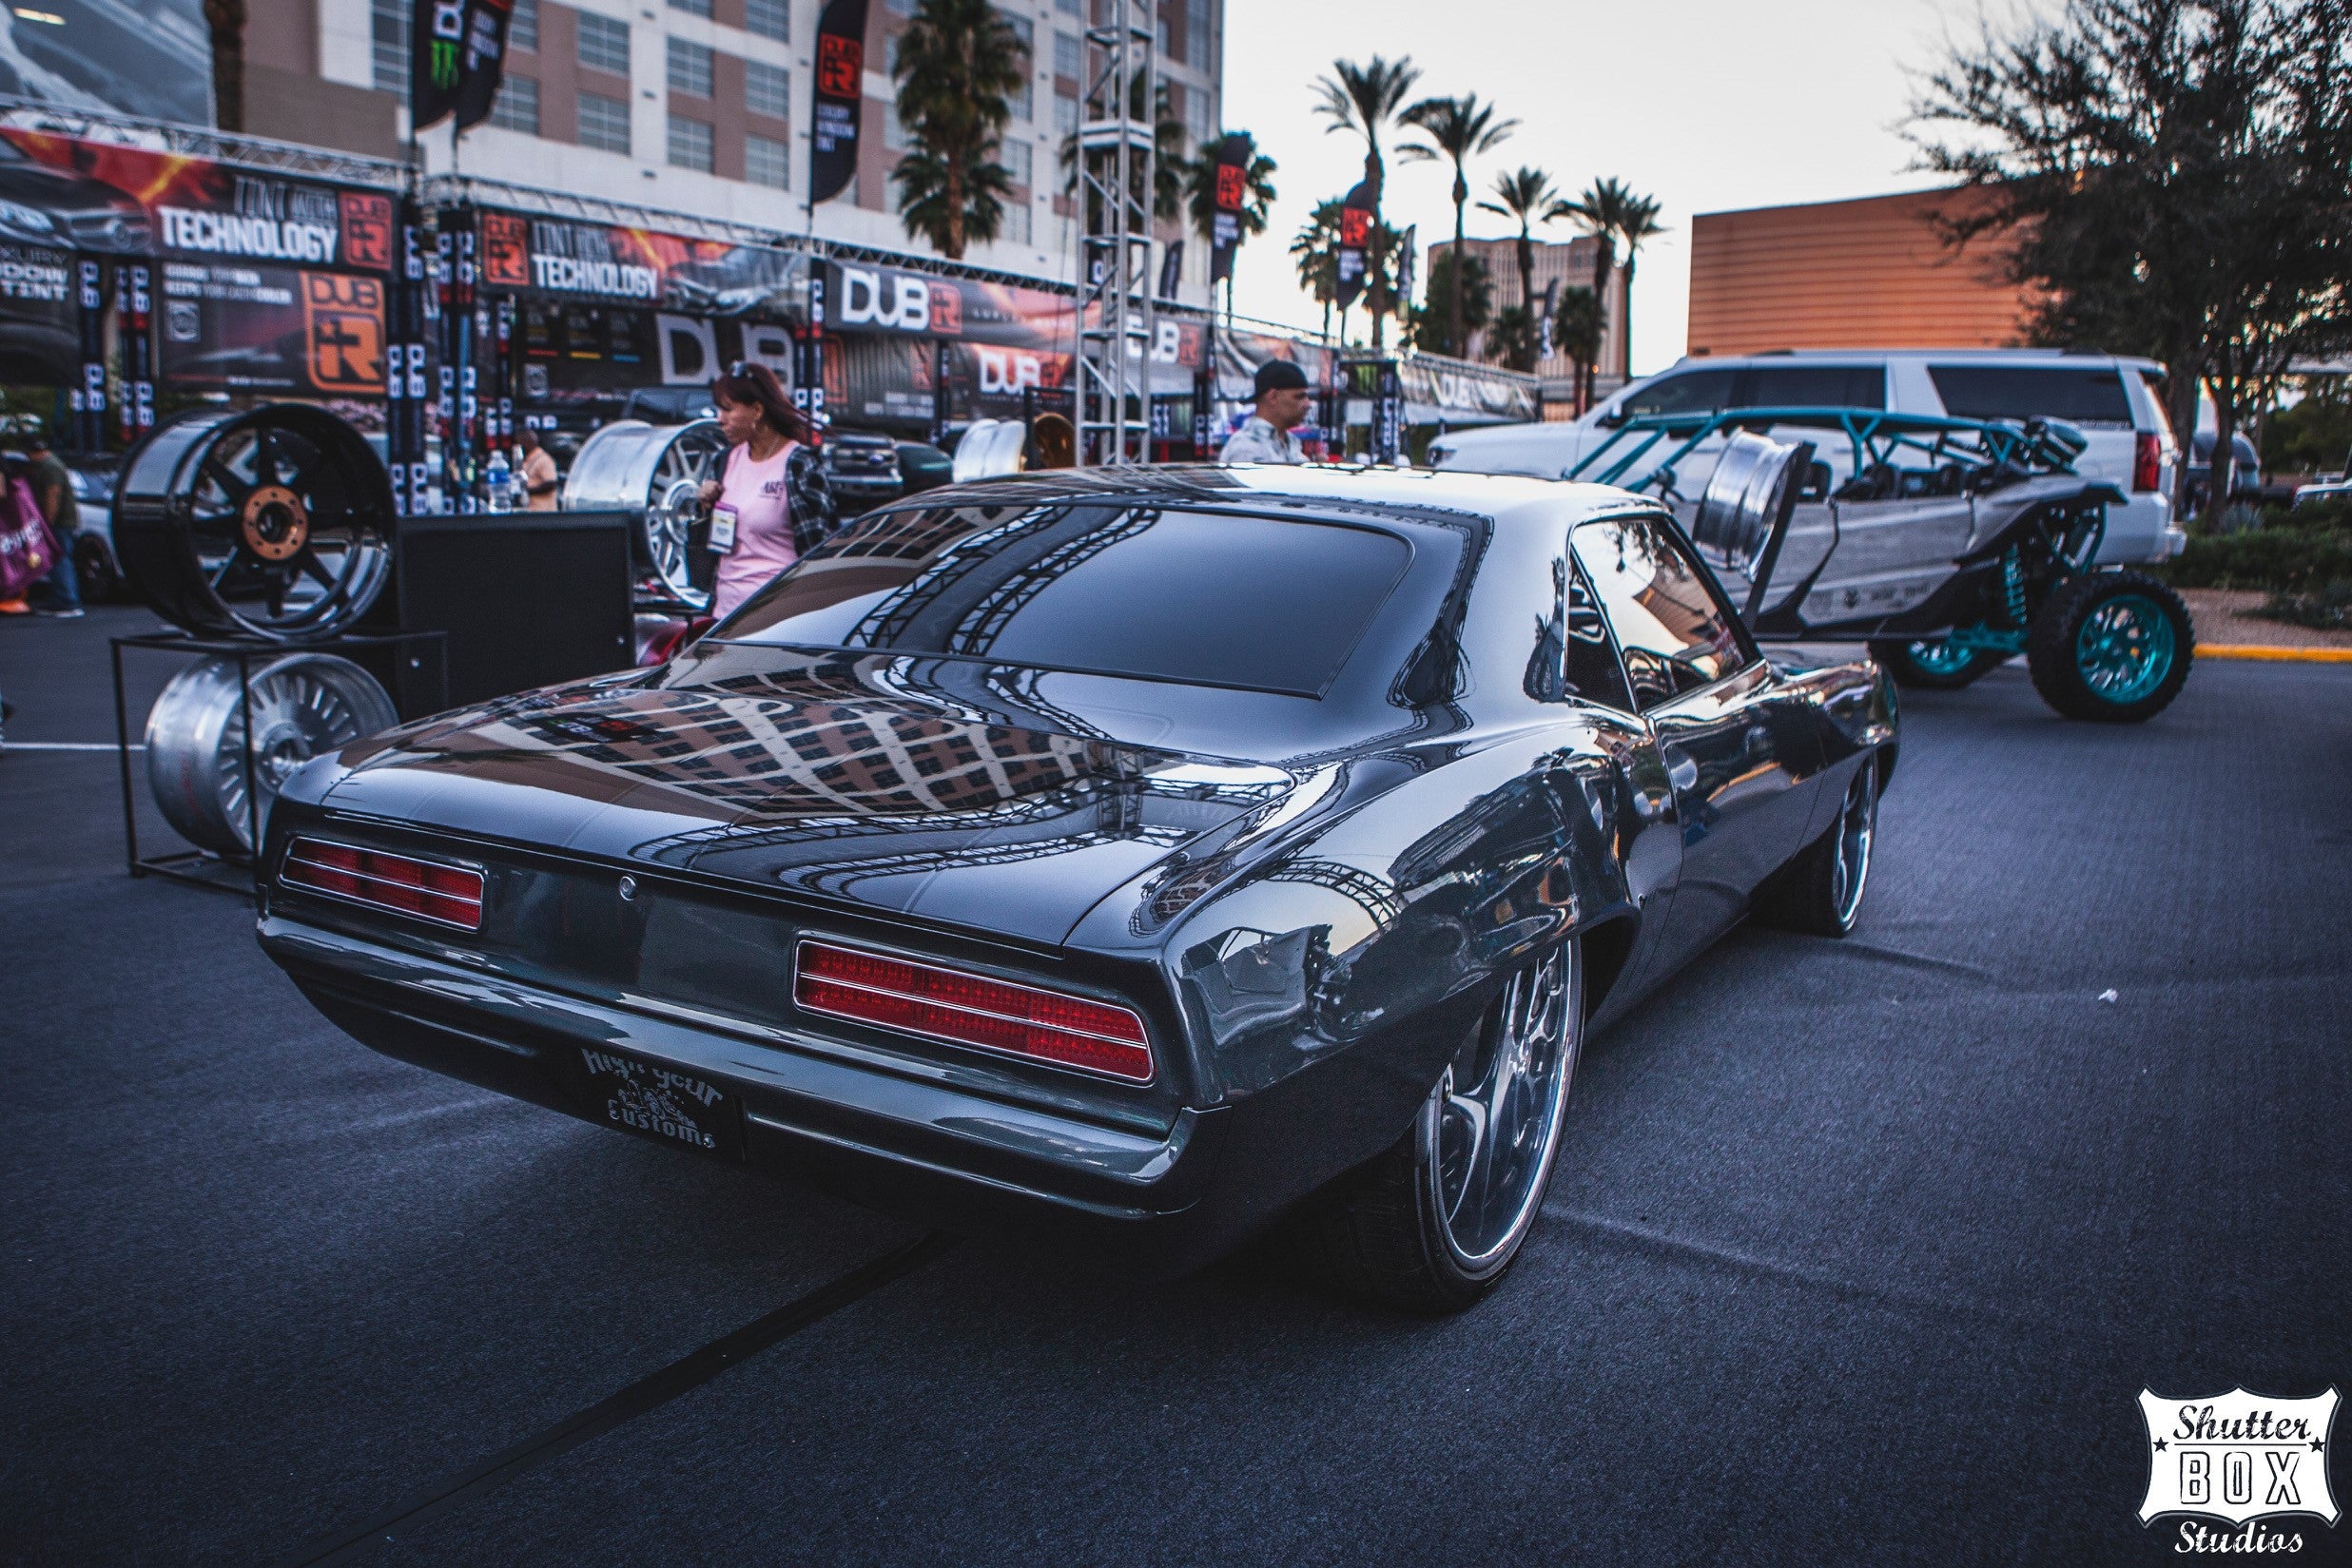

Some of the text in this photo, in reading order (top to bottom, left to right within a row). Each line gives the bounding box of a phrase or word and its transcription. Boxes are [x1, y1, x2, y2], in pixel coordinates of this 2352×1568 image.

[157, 204, 339, 264] TECHNOLOGY
[309, 275, 379, 310] DUB
[530, 252, 658, 300] TECHNOLOGY
[842, 267, 930, 331] DUB
[406, 342, 427, 399] DUB
